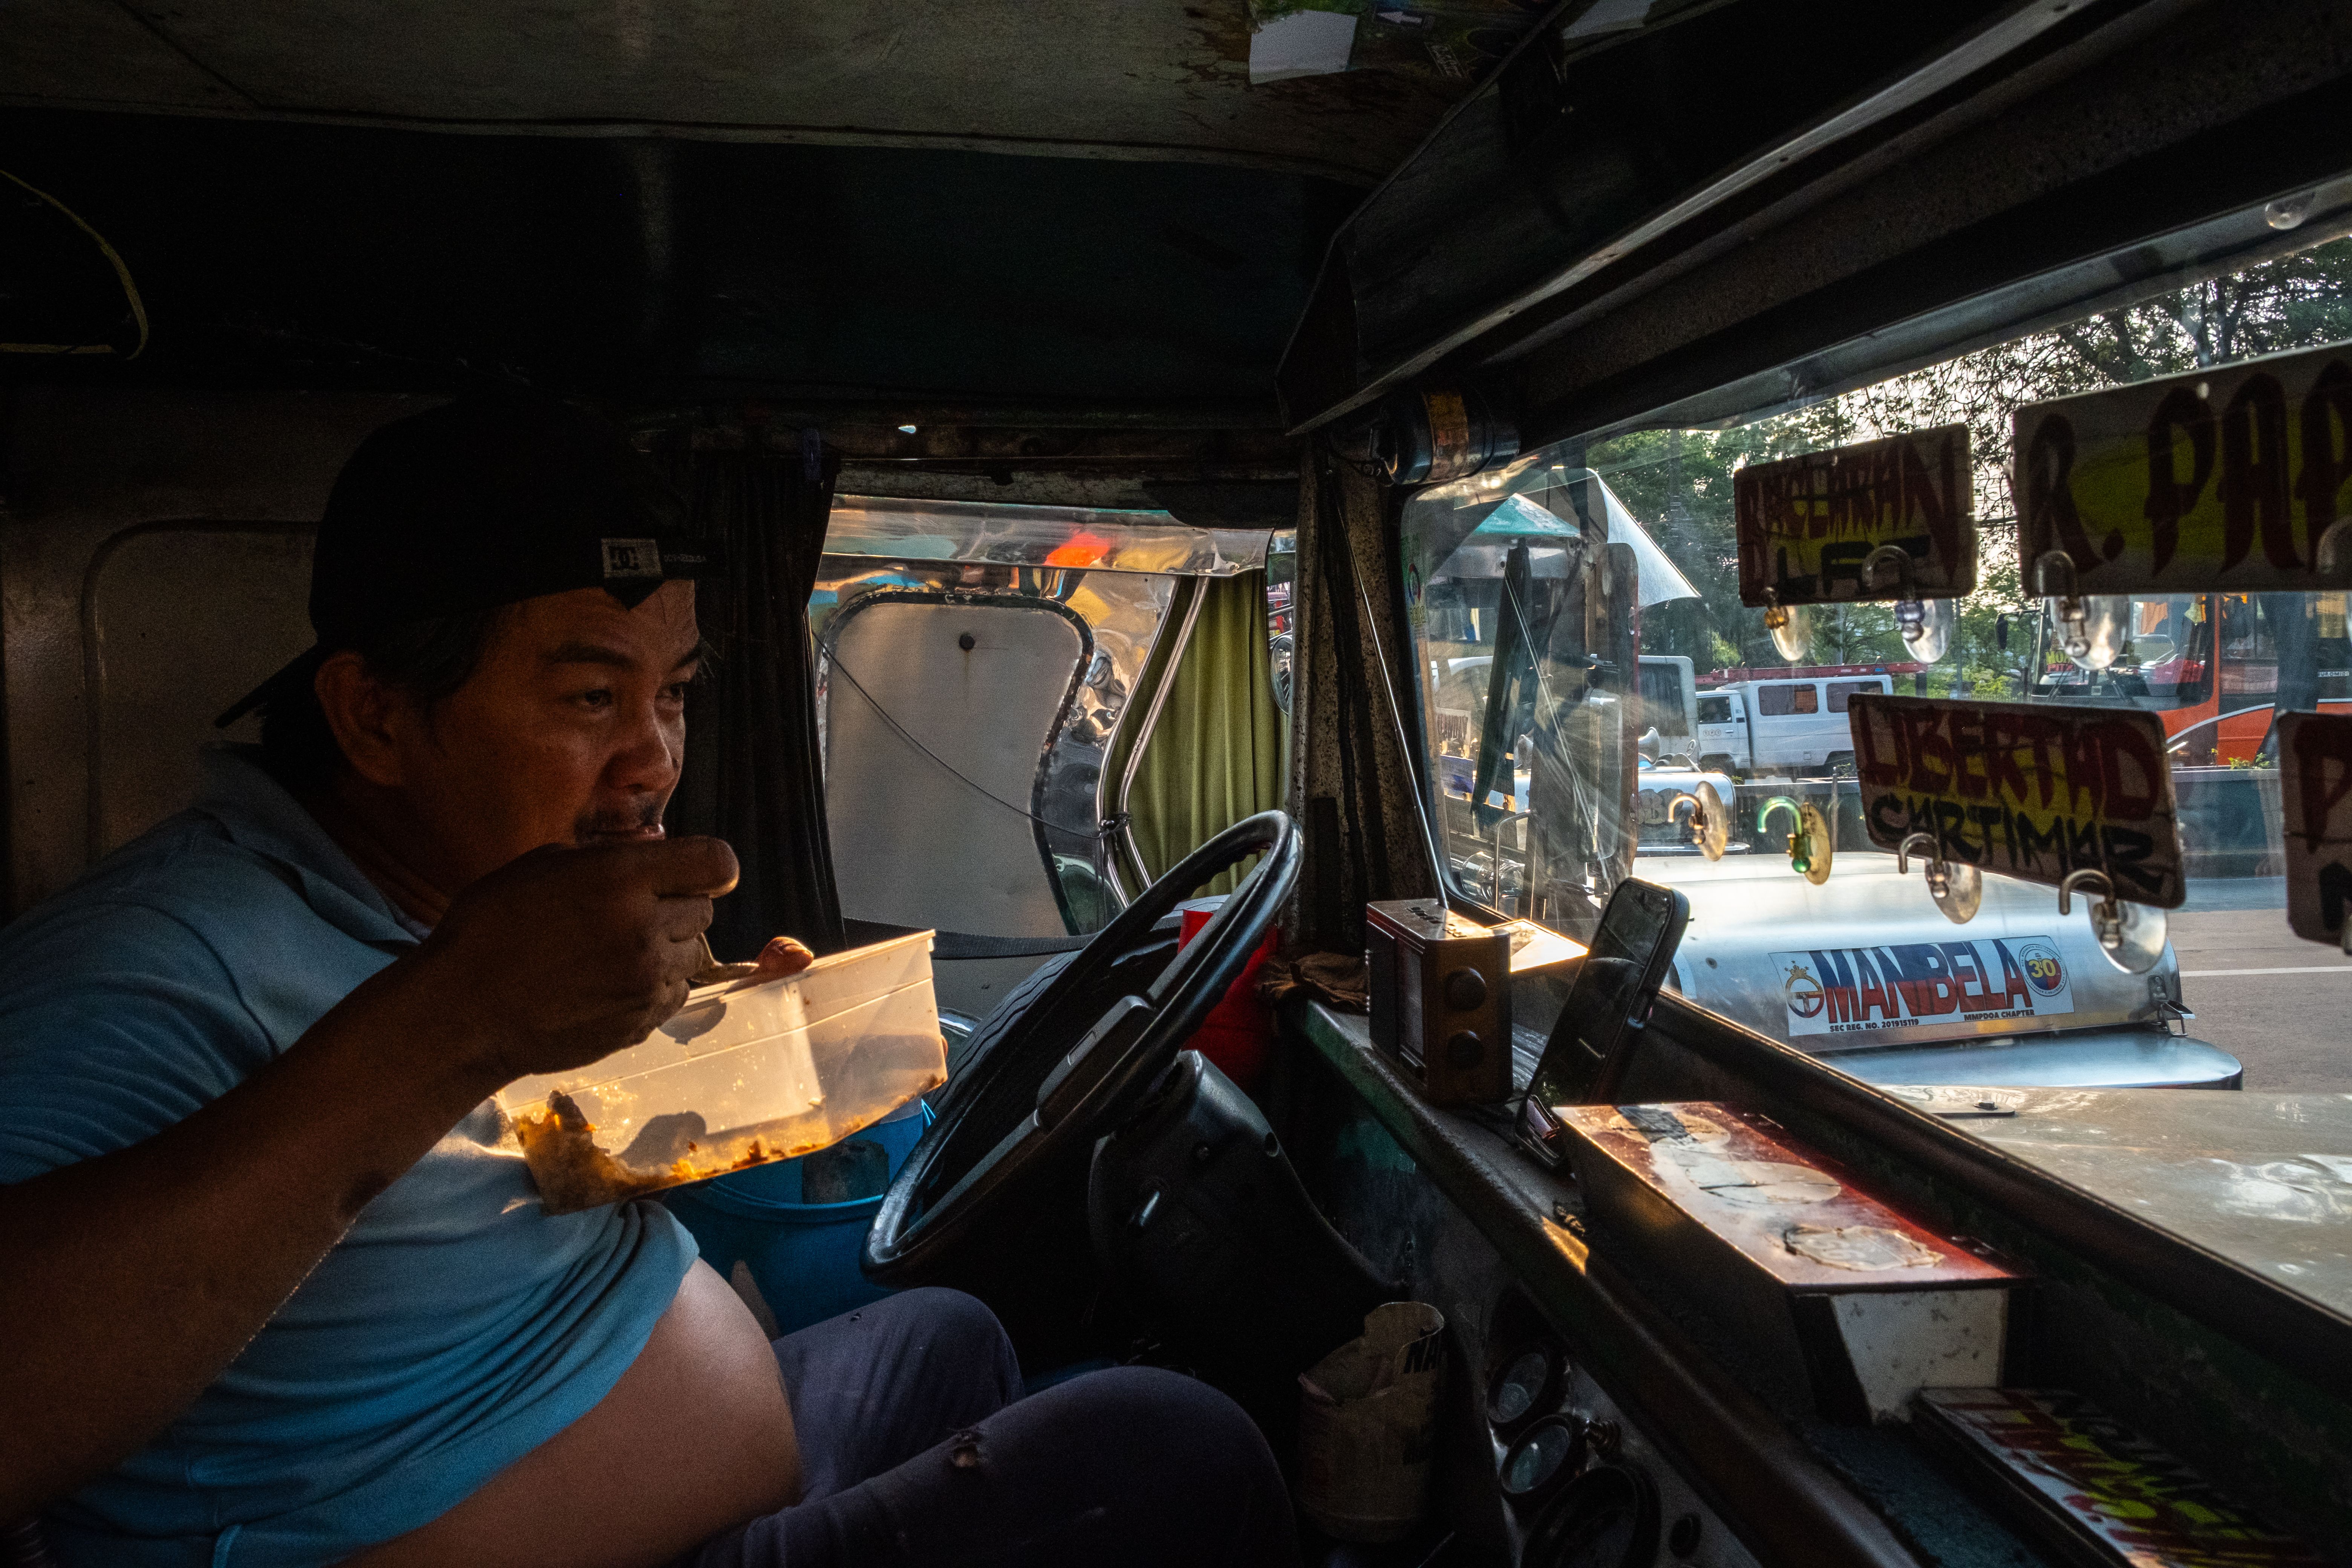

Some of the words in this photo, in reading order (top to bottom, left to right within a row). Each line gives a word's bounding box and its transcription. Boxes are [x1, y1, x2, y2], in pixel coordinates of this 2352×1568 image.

[1859, 703, 2160, 821] LIBERTAD
[1871, 793, 2164, 894] CARTIMAR
[1809, 939, 2033, 1024] MANIBELA
[2028, 958, 2056, 978] 30
[1846, 1023, 1863, 1031] REG.
[1881, 1018, 1919, 1029] 201915119
[1964, 1012, 2000, 1021] MMPDOA
[2001, 1009, 2035, 1018] CHAPTER
